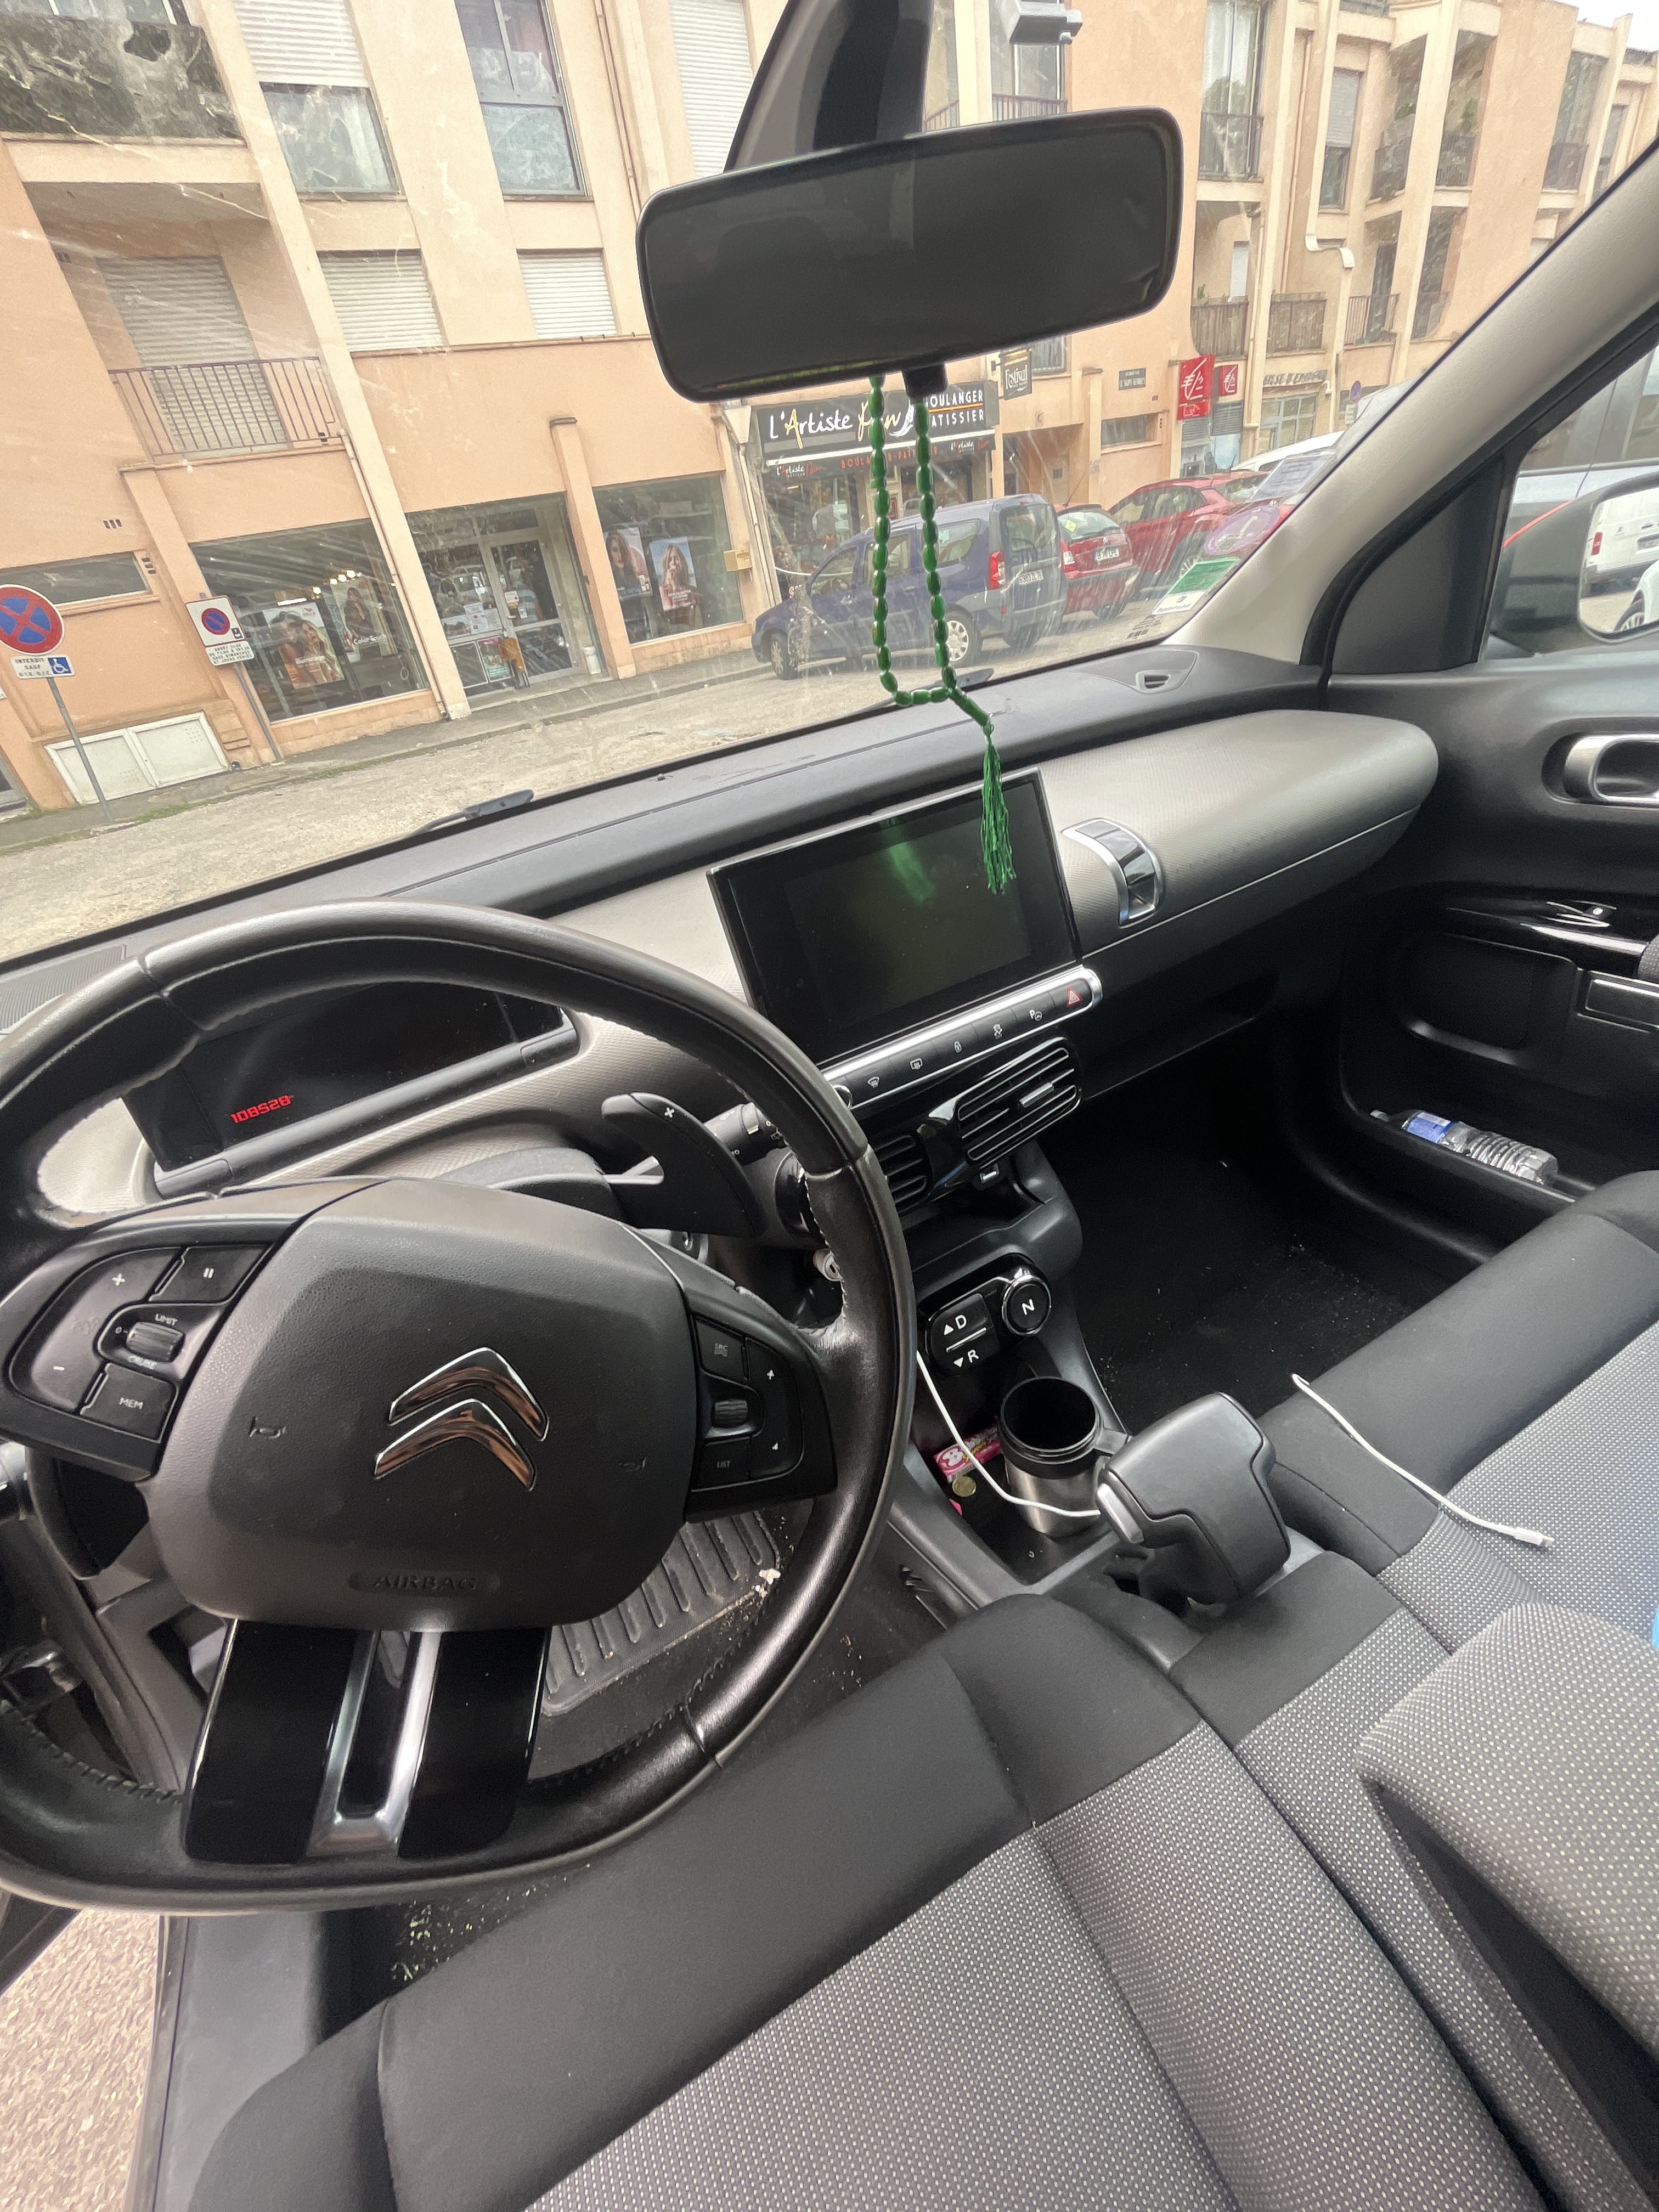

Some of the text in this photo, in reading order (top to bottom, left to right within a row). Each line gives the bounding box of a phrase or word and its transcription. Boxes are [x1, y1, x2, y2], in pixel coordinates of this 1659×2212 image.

[926, 390, 984, 408] OULANGER
[932, 409, 984, 427] ATISSIER
[770, 408, 854, 449] L'Artiste
[230, 1094, 291, 1124] 108528
[1021, 1299, 1035, 1315] N
[955, 1314, 967, 1329] D
[967, 1349, 979, 1363] R
[119, 1397, 143, 1410] MEM
[373, 1575, 476, 1590] AIRBAG
